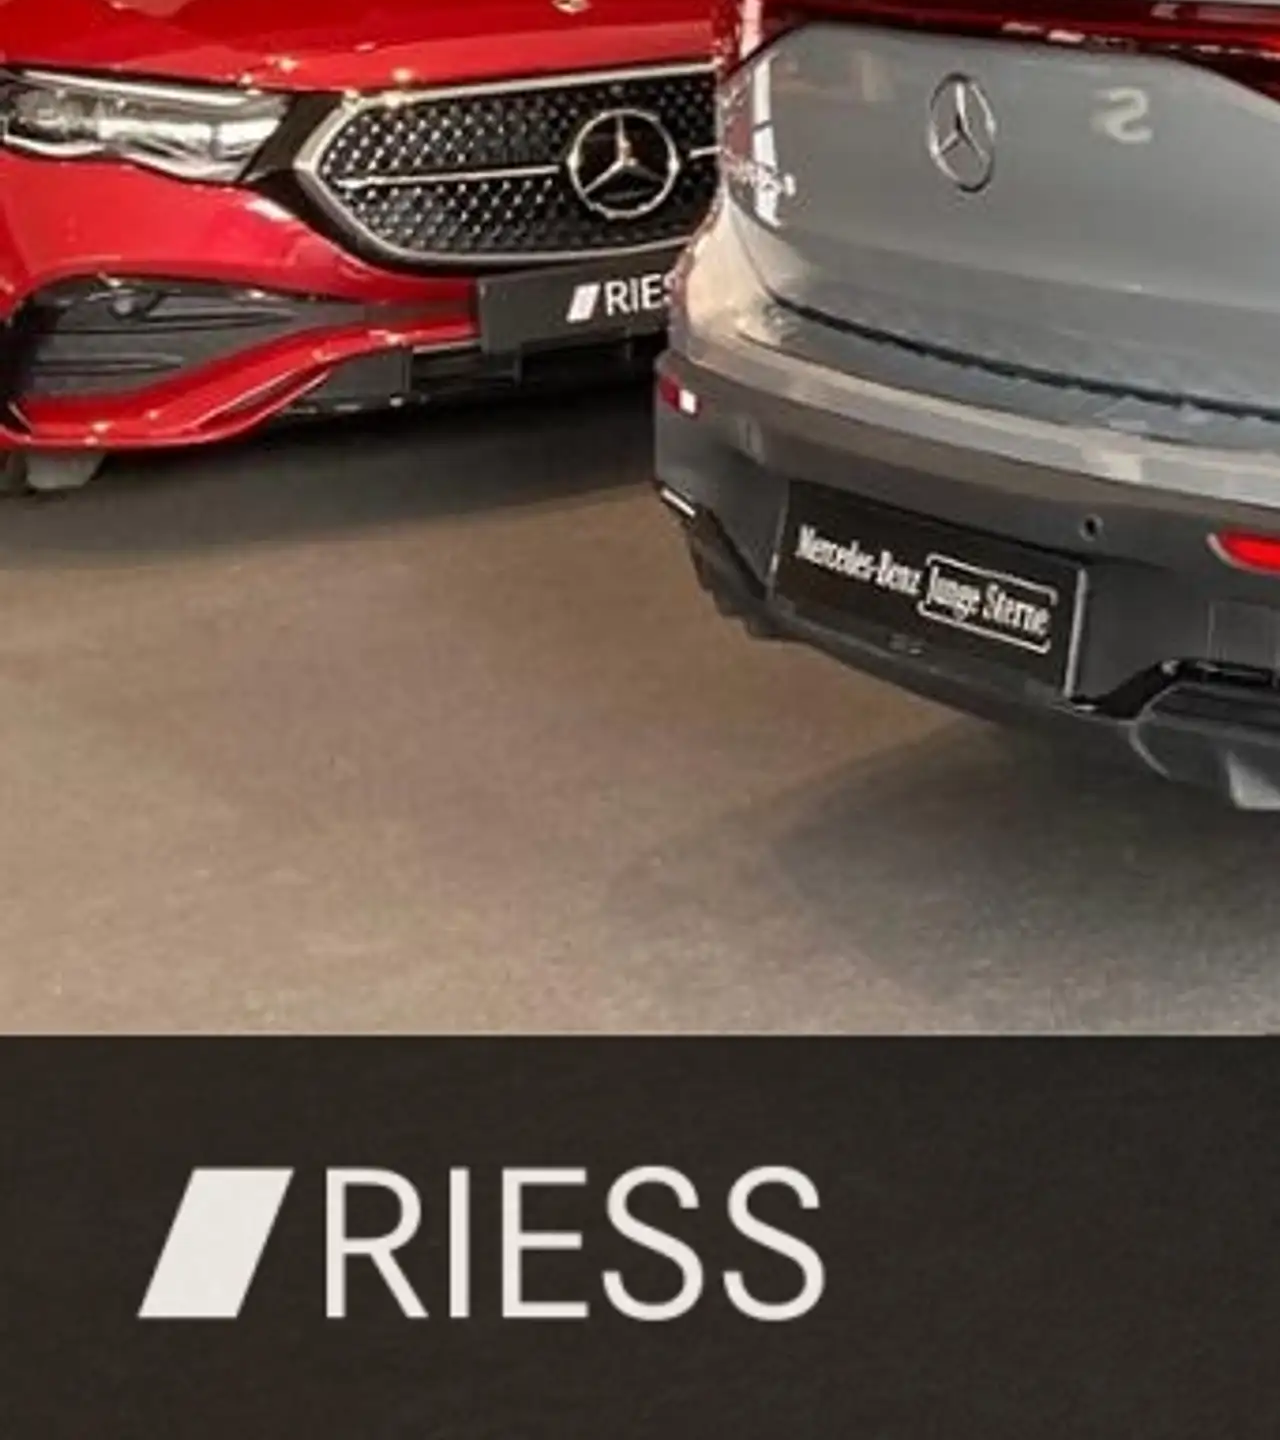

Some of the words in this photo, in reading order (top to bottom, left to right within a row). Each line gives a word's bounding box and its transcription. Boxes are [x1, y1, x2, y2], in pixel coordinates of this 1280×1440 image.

[796, 524, 921, 596] Mercedes-Benz
[927, 566, 981, 620] Junge
[983, 581, 1050, 636] Sterne
